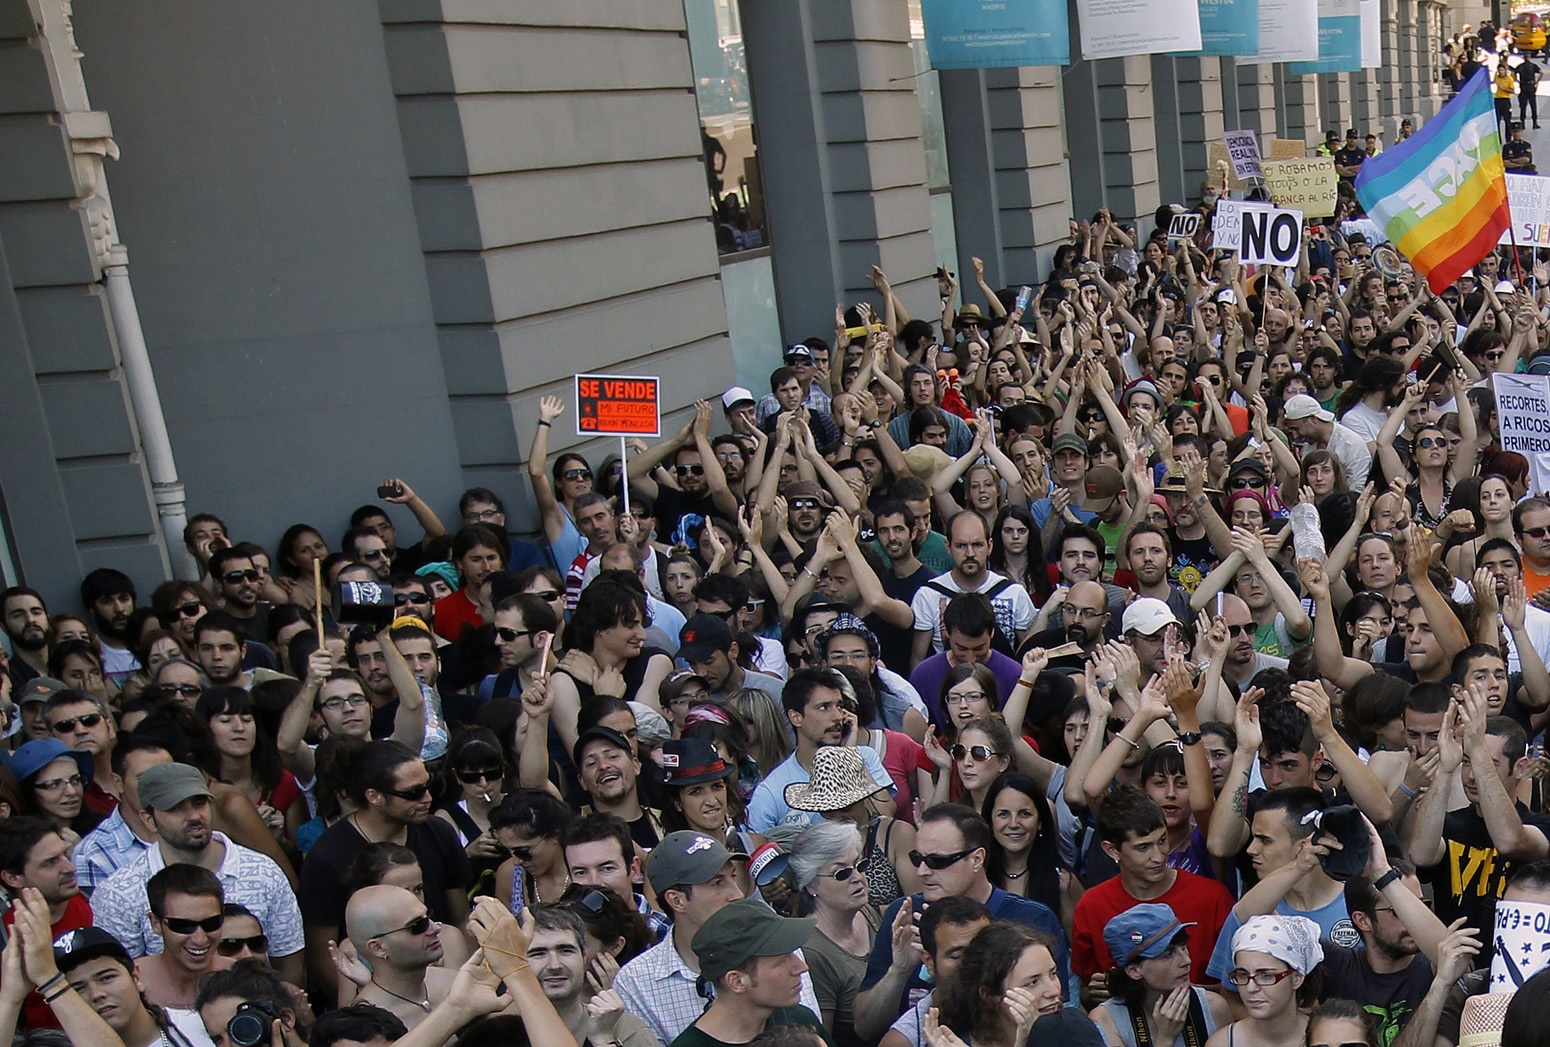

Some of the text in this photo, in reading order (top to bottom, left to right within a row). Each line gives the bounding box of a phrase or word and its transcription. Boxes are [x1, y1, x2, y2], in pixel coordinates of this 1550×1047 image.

[1230, 149, 1251, 161] REAL
[1279, 161, 1333, 176] ROBAMOS
[1303, 178, 1311, 187] O
[1315, 178, 1327, 186] LA
[1274, 194, 1305, 205] BANCA
[1309, 194, 1319, 203] AL
[1220, 204, 1234, 213] LO
[1170, 216, 1197, 235] NO
[1241, 212, 1299, 262] NO
[580, 379, 656, 400] SE VENDE
[617, 403, 655, 414] FUTURO
[1499, 395, 1550, 416] RECORTES,
[1503, 416, 1550, 433] A RICOS
[1136, 1016, 1148, 1043] Nikon
